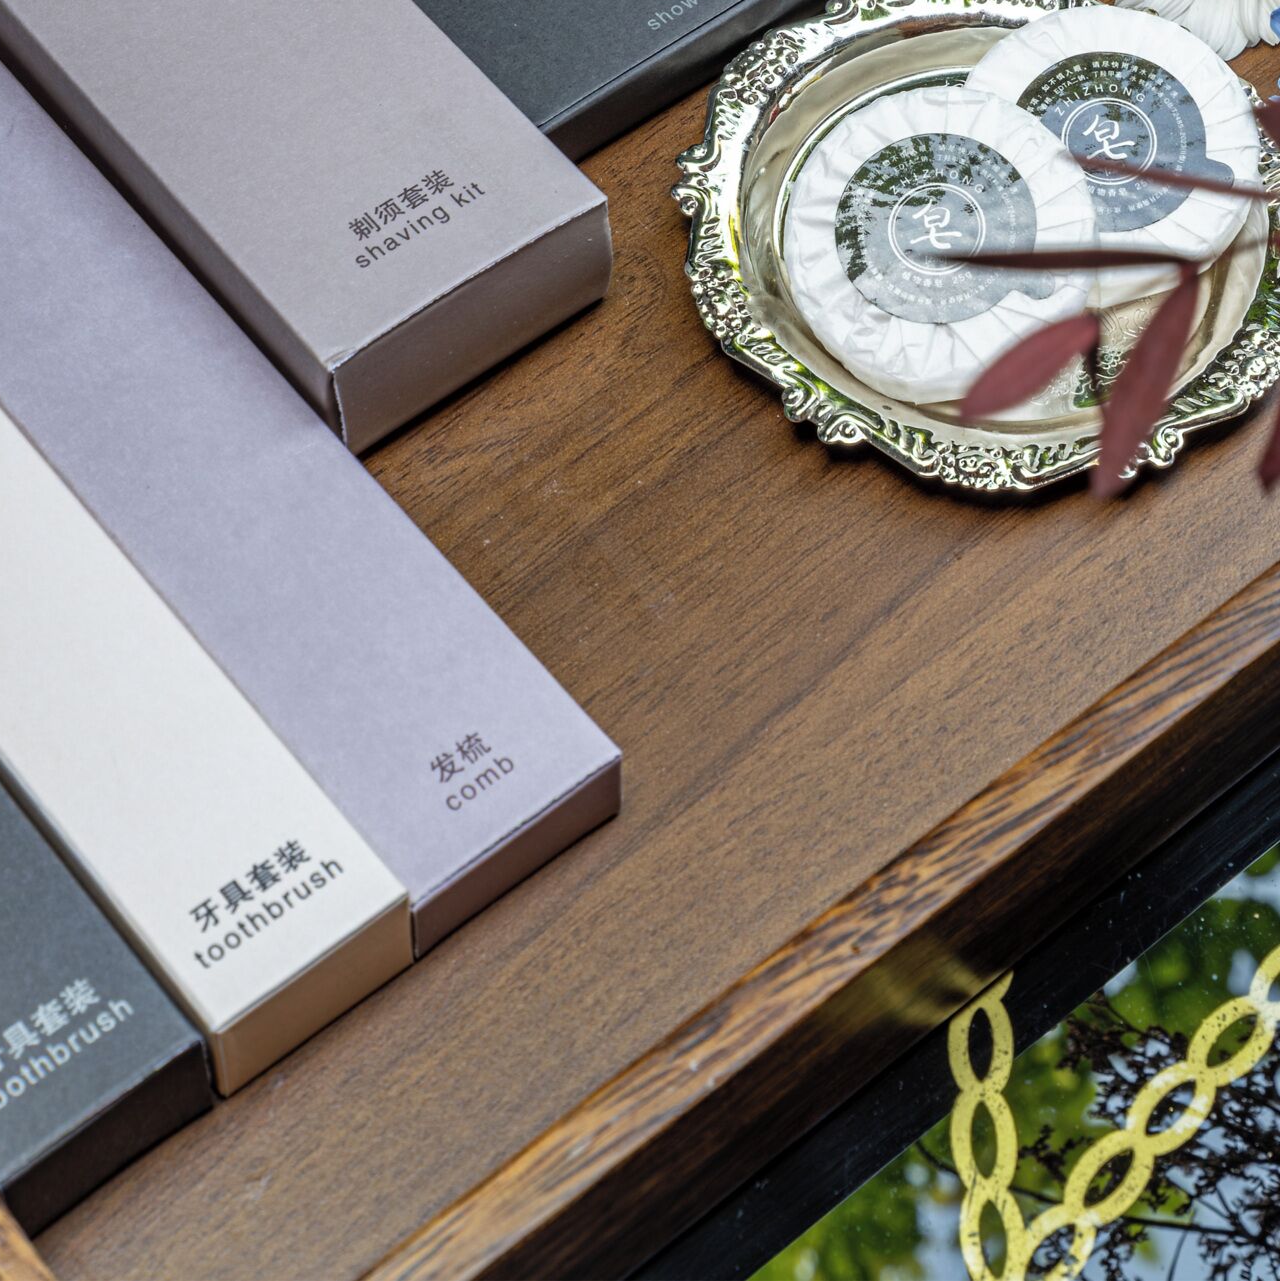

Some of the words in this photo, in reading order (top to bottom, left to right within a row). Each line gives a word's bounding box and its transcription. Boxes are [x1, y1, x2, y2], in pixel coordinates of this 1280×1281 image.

[1054, 83, 1147, 117] ZHIZHONG
[1082, 114, 1136, 160] 皂
[348, 169, 455, 241] 剃须套装
[889, 169, 985, 195] ZHIZHONG
[355, 205, 450, 269] shaving
[450, 182, 486, 208] kit
[909, 199, 963, 250] 皂
[431, 732, 492, 783] 发梳
[446, 757, 514, 811] comb
[189, 839, 312, 934] 牙具套装
[194, 858, 345, 970] toothbrush
